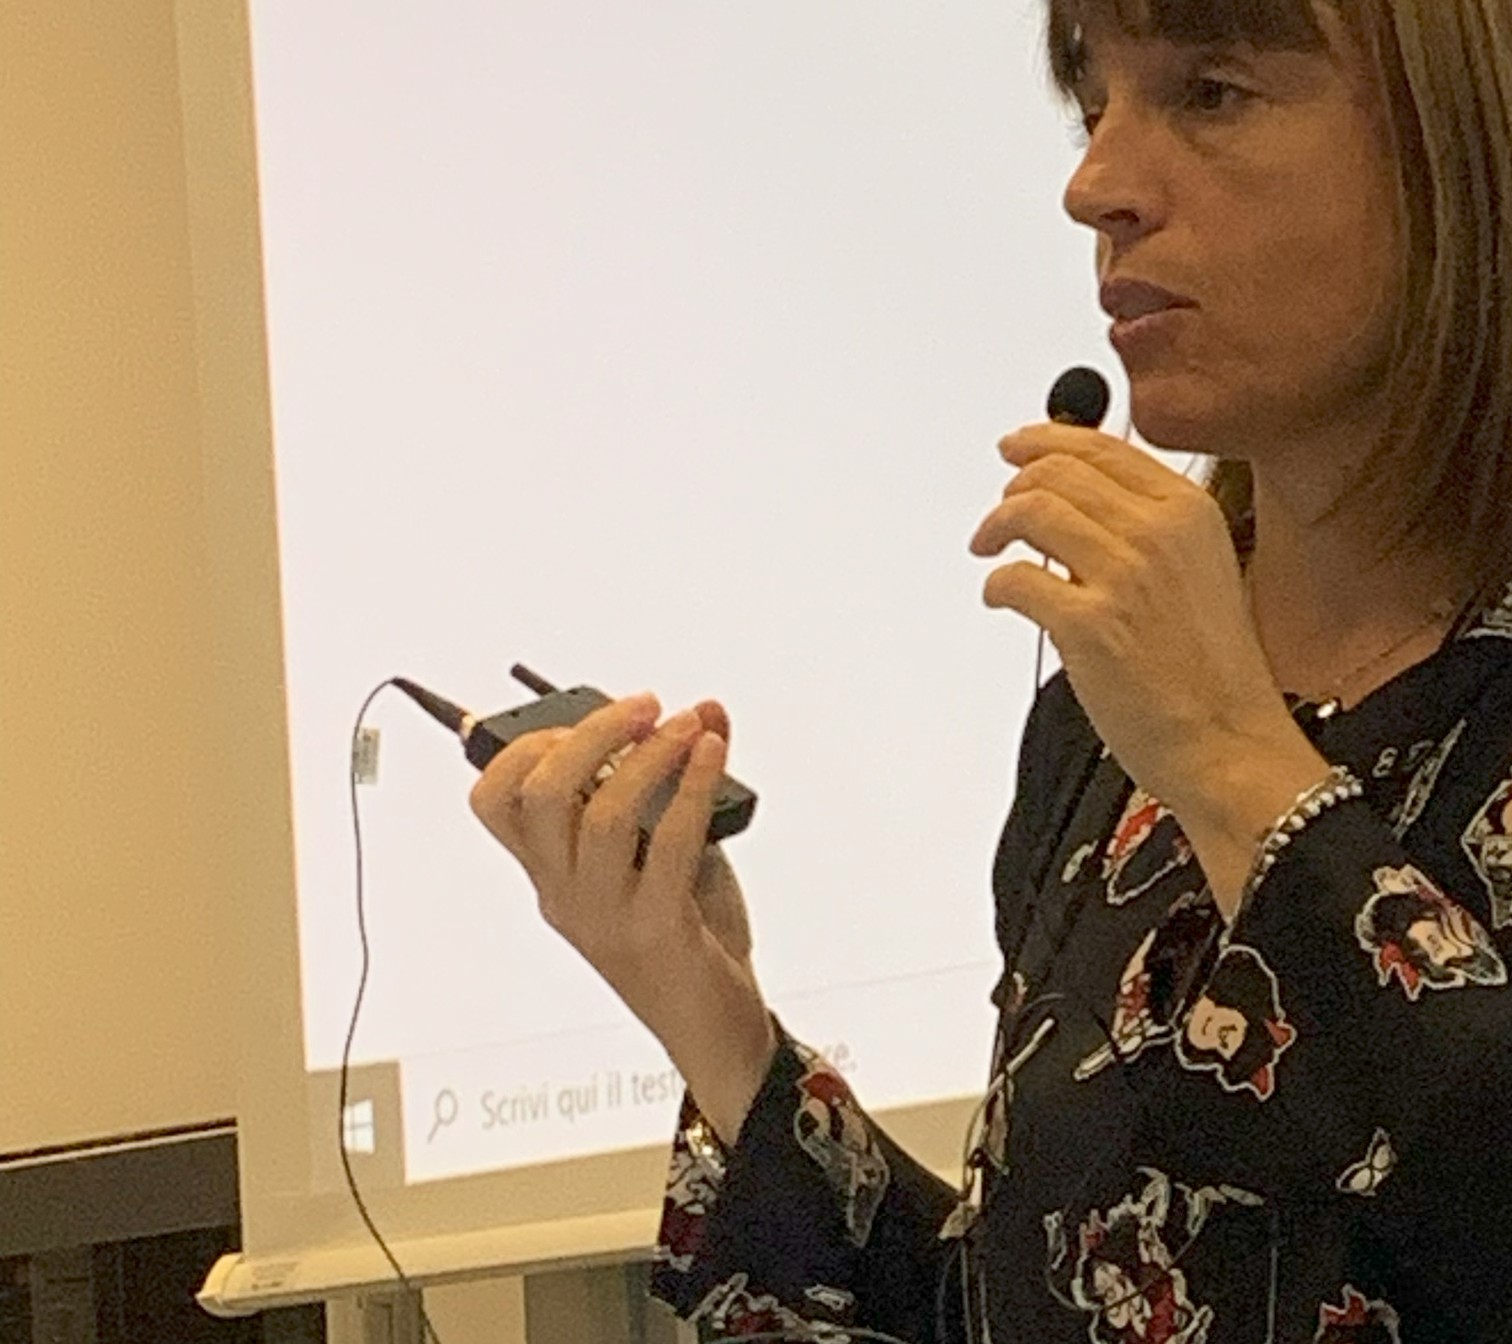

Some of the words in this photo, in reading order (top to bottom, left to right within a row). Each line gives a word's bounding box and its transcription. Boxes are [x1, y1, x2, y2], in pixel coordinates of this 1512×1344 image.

[481, 1083, 548, 1130] Scrivi
[558, 1074, 599, 1124] qui
[607, 1072, 622, 1106] il
[631, 1068, 685, 1105] test
